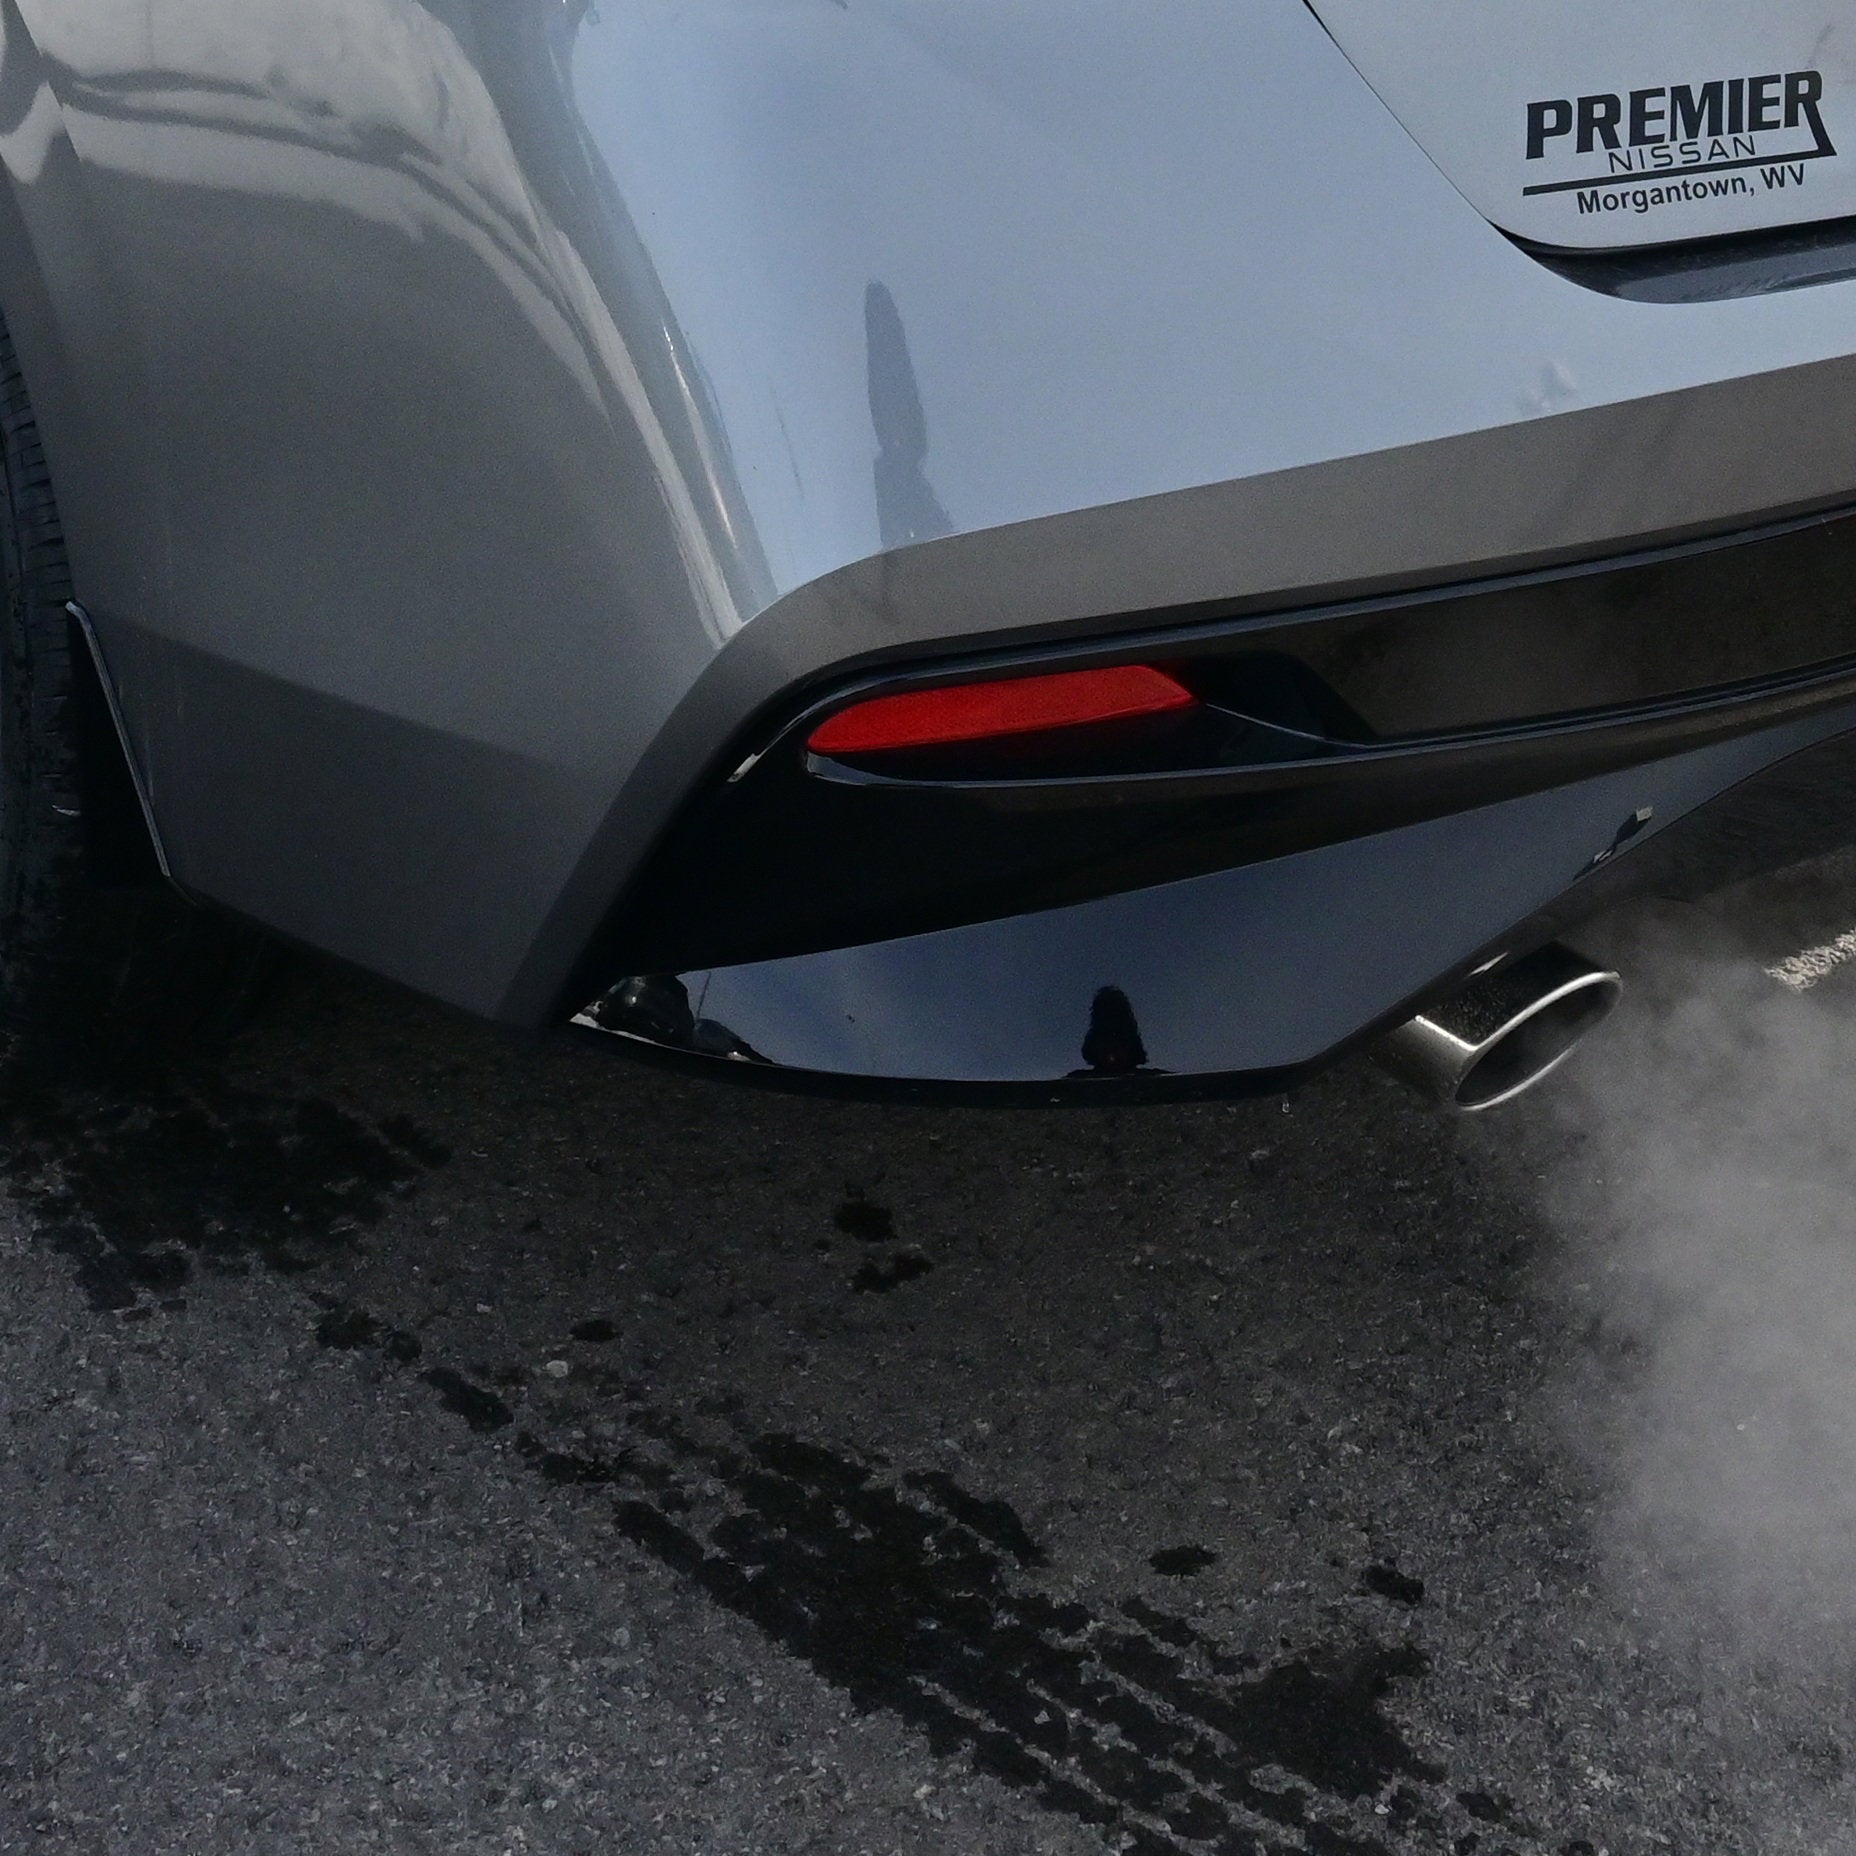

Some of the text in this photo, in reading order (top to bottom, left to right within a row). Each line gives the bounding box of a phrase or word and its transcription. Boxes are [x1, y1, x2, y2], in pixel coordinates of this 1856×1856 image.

[1526, 70, 1836, 160] PREMIER
[1608, 135, 1756, 173] NISSAN
[1576, 163, 1805, 214] Morgantown, WV
